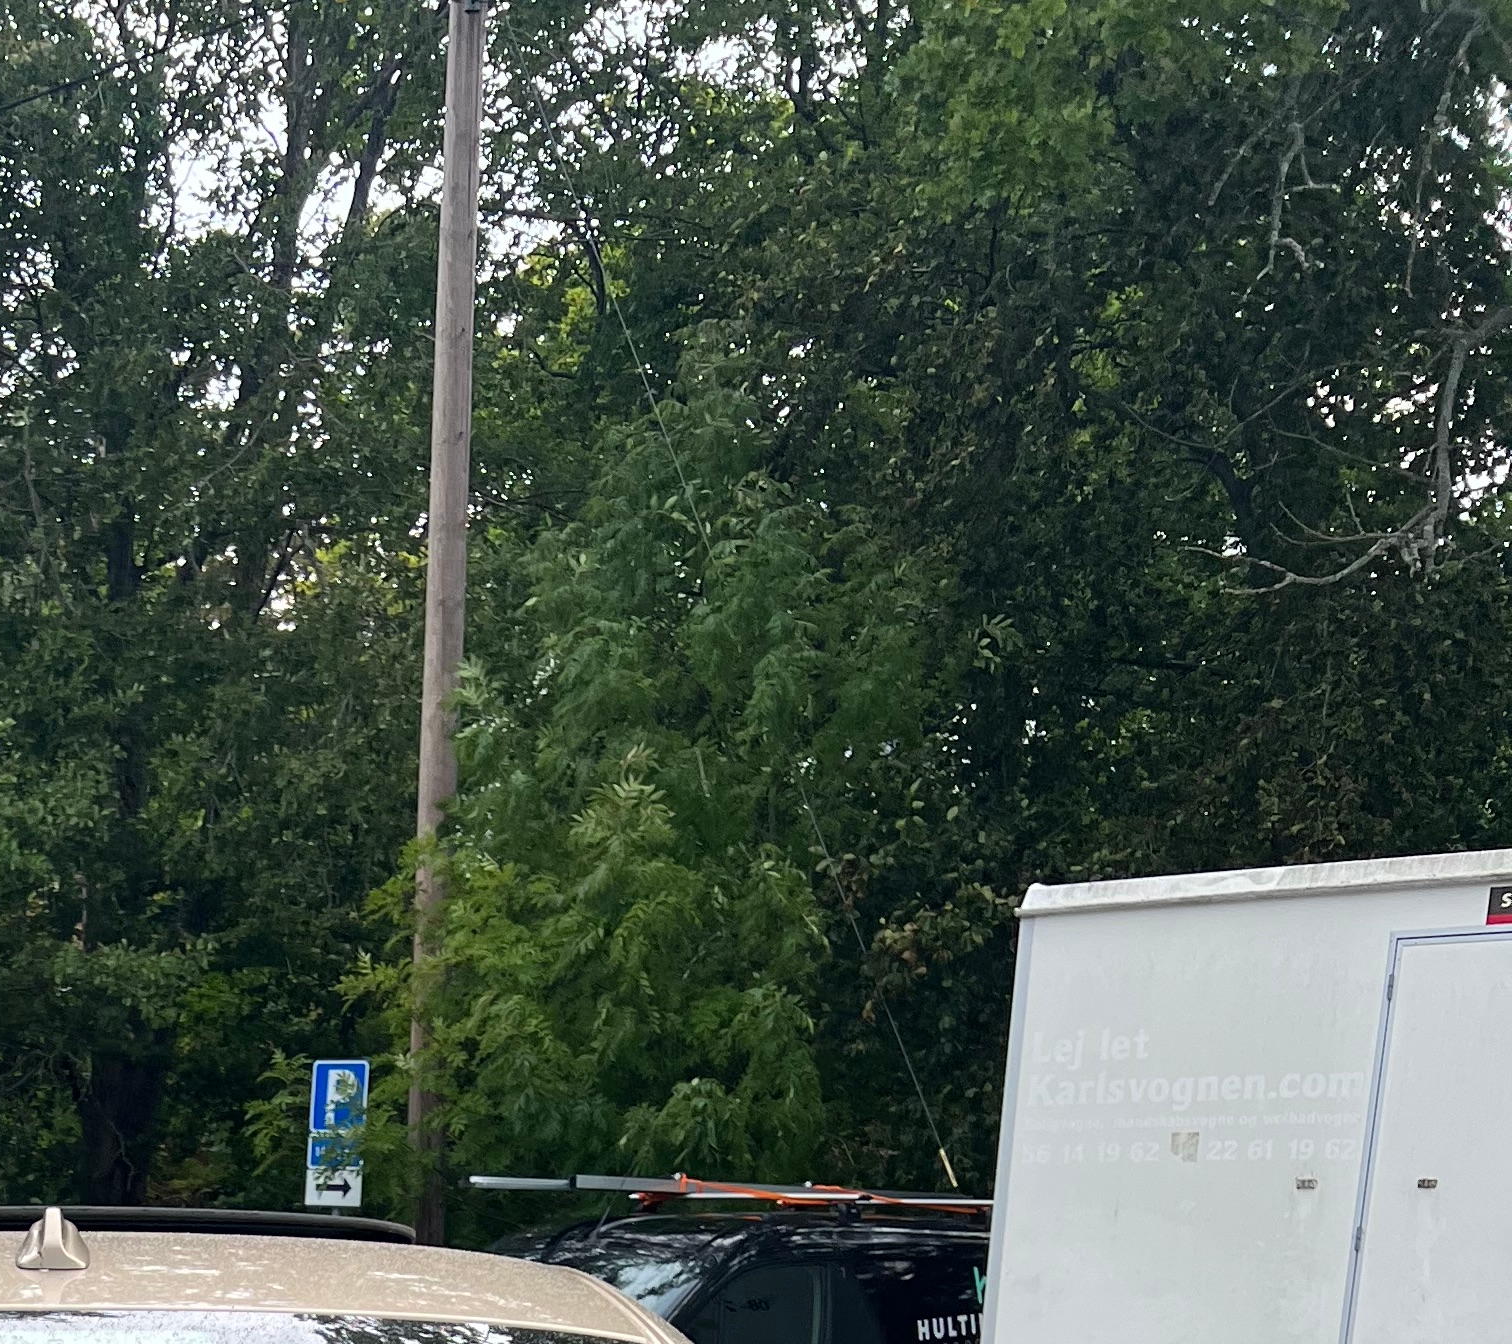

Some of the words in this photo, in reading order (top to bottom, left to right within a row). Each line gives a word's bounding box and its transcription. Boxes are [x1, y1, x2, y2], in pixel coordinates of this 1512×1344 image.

[1031, 1030, 1086, 1071] Lej
[1099, 1028, 1150, 1061] let
[324, 1069, 358, 1126] P
[1026, 1069, 1365, 1112] Karlsvognen.com
[1239, 1114, 1258, 1129] og
[1062, 1142, 1085, 1165] 14
[1097, 1141, 1122, 1163] 19
[1129, 1140, 1161, 1162] 62
[1205, 1139, 1239, 1161] 22
[1246, 1138, 1274, 1161] 61
[1287, 1138, 1315, 1160] 19
[1323, 1138, 1358, 1160] 62
